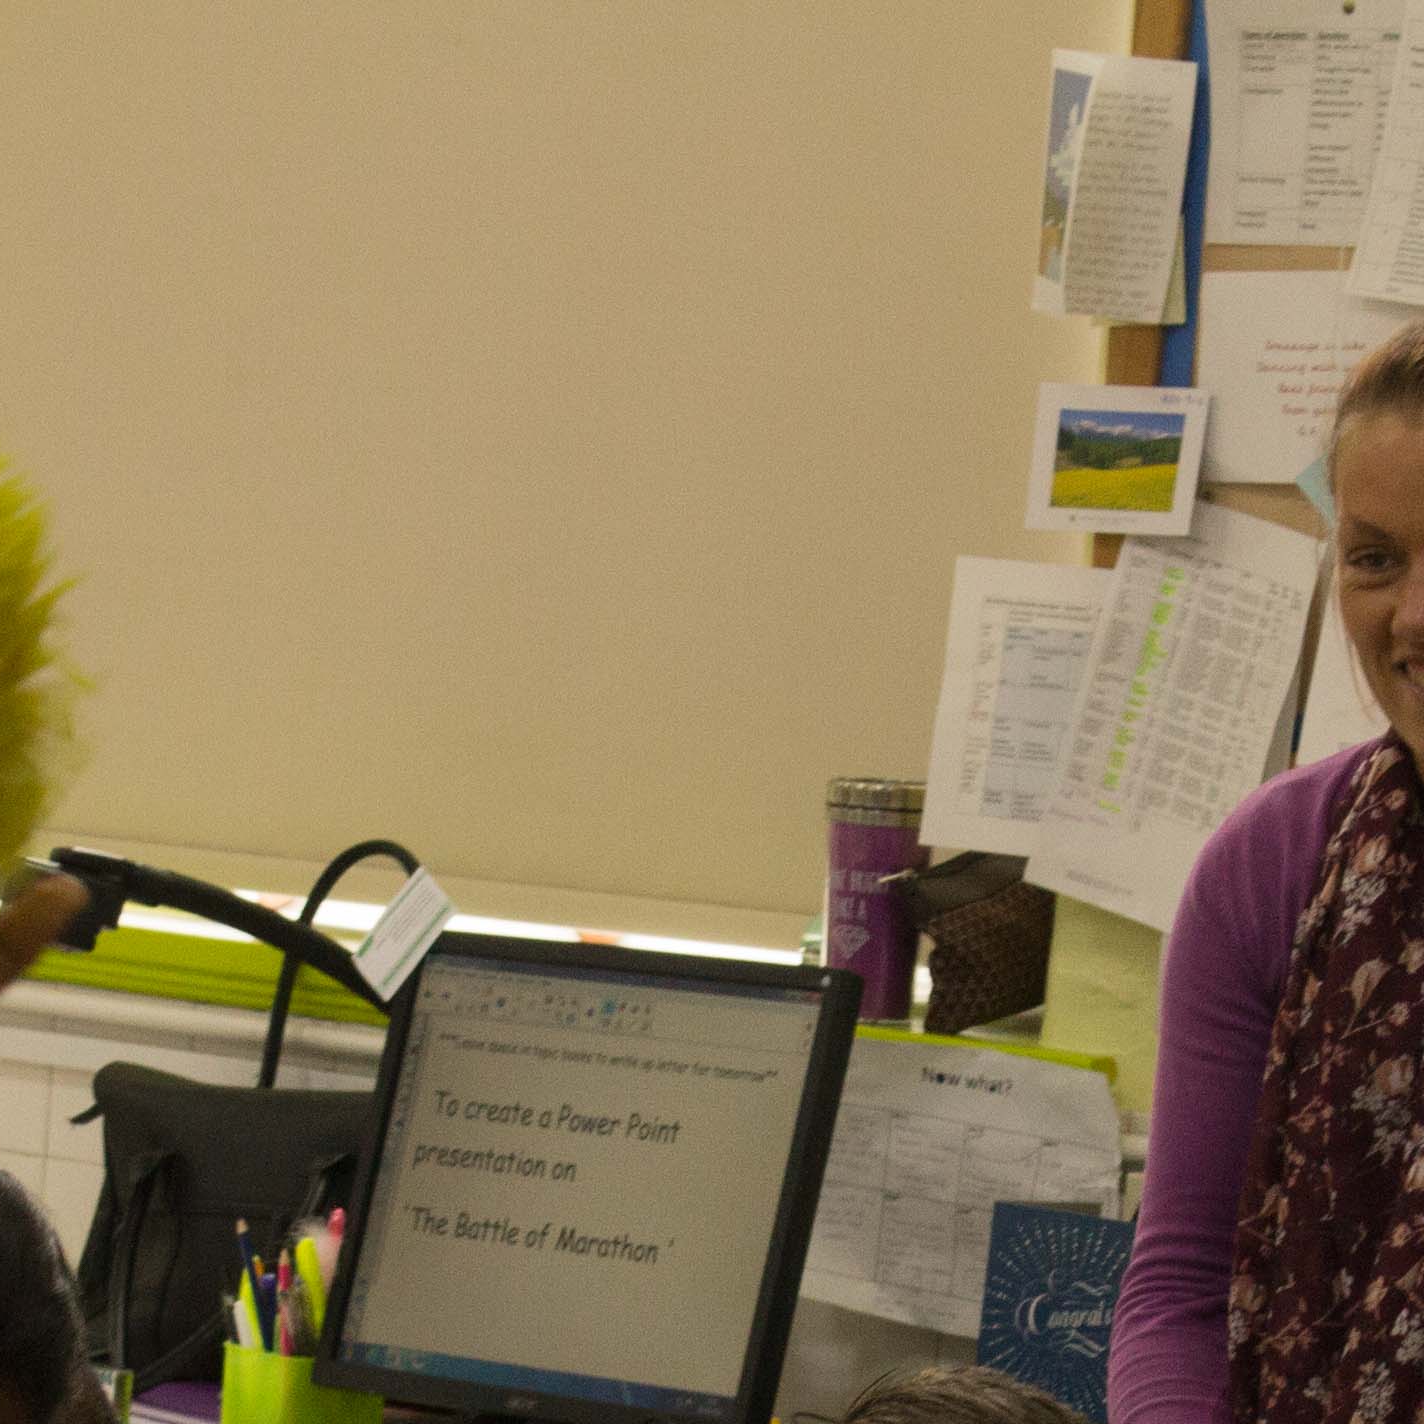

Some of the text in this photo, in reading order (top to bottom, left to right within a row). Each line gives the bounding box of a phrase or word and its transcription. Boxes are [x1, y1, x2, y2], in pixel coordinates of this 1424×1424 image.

[921, 1066, 1014, 1096] Now what?
[434, 1089, 682, 1145] To create a Power Point
[411, 1141, 576, 1183] presentation on
[453, 1211, 520, 1247] Battle
[524, 1223, 553, 1250] of
[554, 1225, 660, 1266] Marathon
